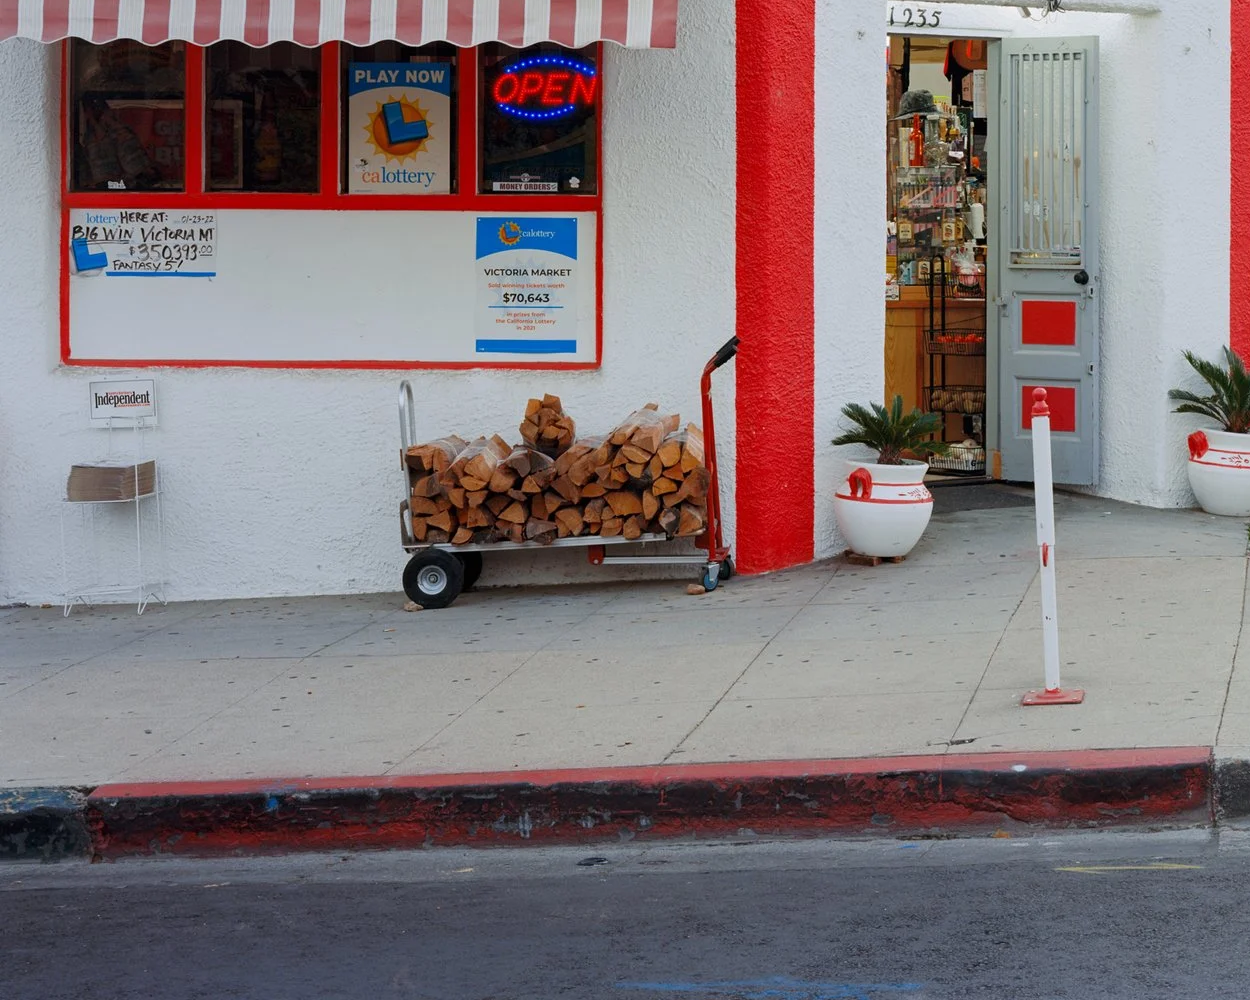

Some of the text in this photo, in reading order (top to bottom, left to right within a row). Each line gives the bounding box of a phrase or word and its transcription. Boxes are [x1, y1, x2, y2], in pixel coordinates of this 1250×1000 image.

[890, 6, 942, 28] 1235
[354, 70, 445, 84] PLAY NOW
[493, 71, 597, 105] OPEN
[362, 166, 435, 188] calottery
[86, 212, 118, 225] lottery
[120, 212, 168, 224] HERE AT:
[72, 225, 98, 240] BIG
[140, 226, 194, 242] VICTORIA
[522, 229, 556, 239] calottery
[113, 260, 161, 271] FANTASY
[503, 292, 550, 304] $70,643
[94, 390, 150, 408] Independent
